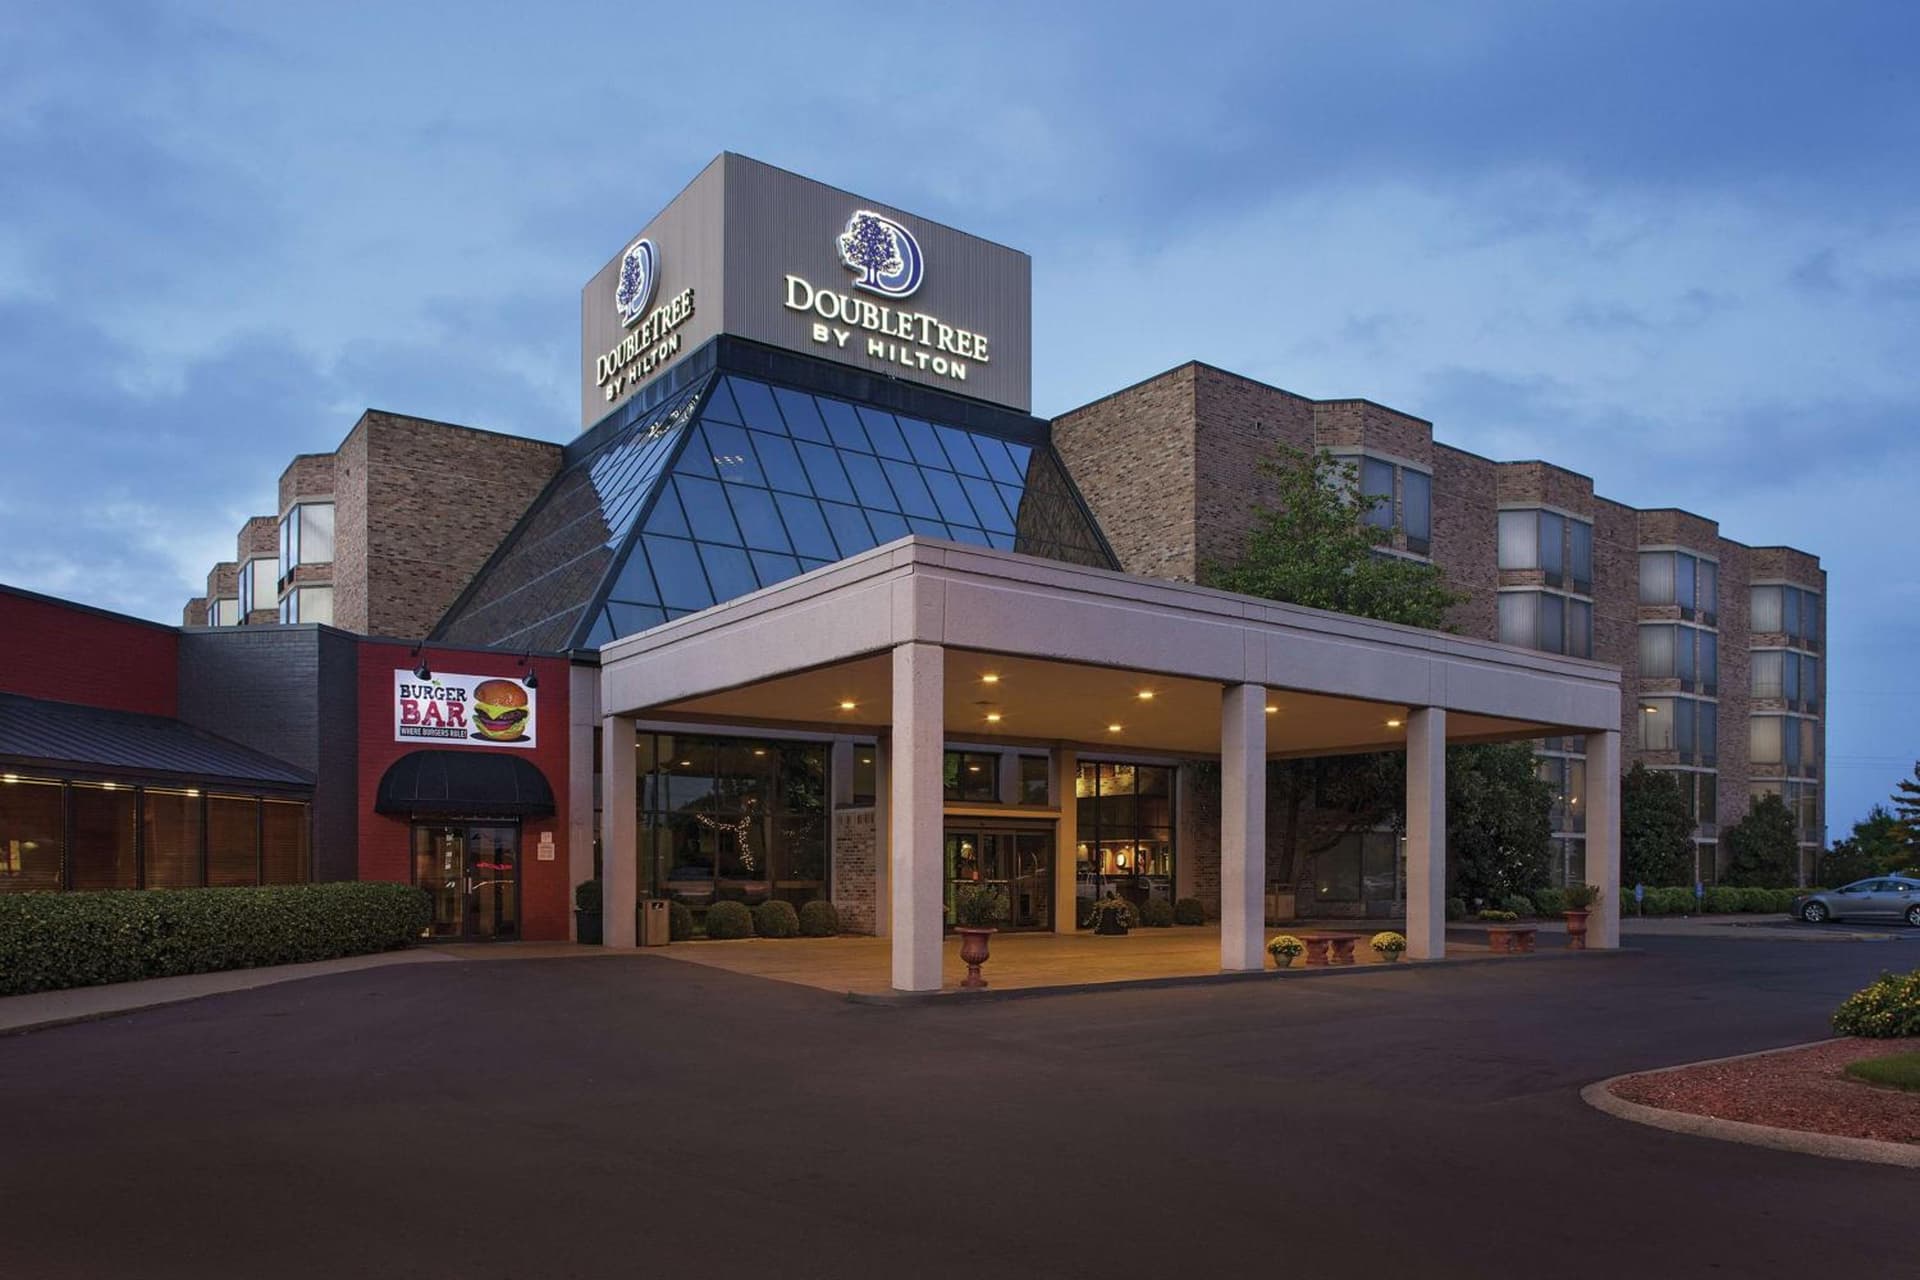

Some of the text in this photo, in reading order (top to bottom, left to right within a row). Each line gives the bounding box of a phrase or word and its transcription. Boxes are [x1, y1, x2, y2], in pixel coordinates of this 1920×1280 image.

[596, 287, 694, 387] DOUBLETREE
[785, 274, 990, 363] DOUBLETREE
[606, 333, 680, 402] BY HILTON
[813, 323, 967, 380] BY HILTON
[400, 684, 468, 702] BURGER
[400, 699, 468, 728] BAR
